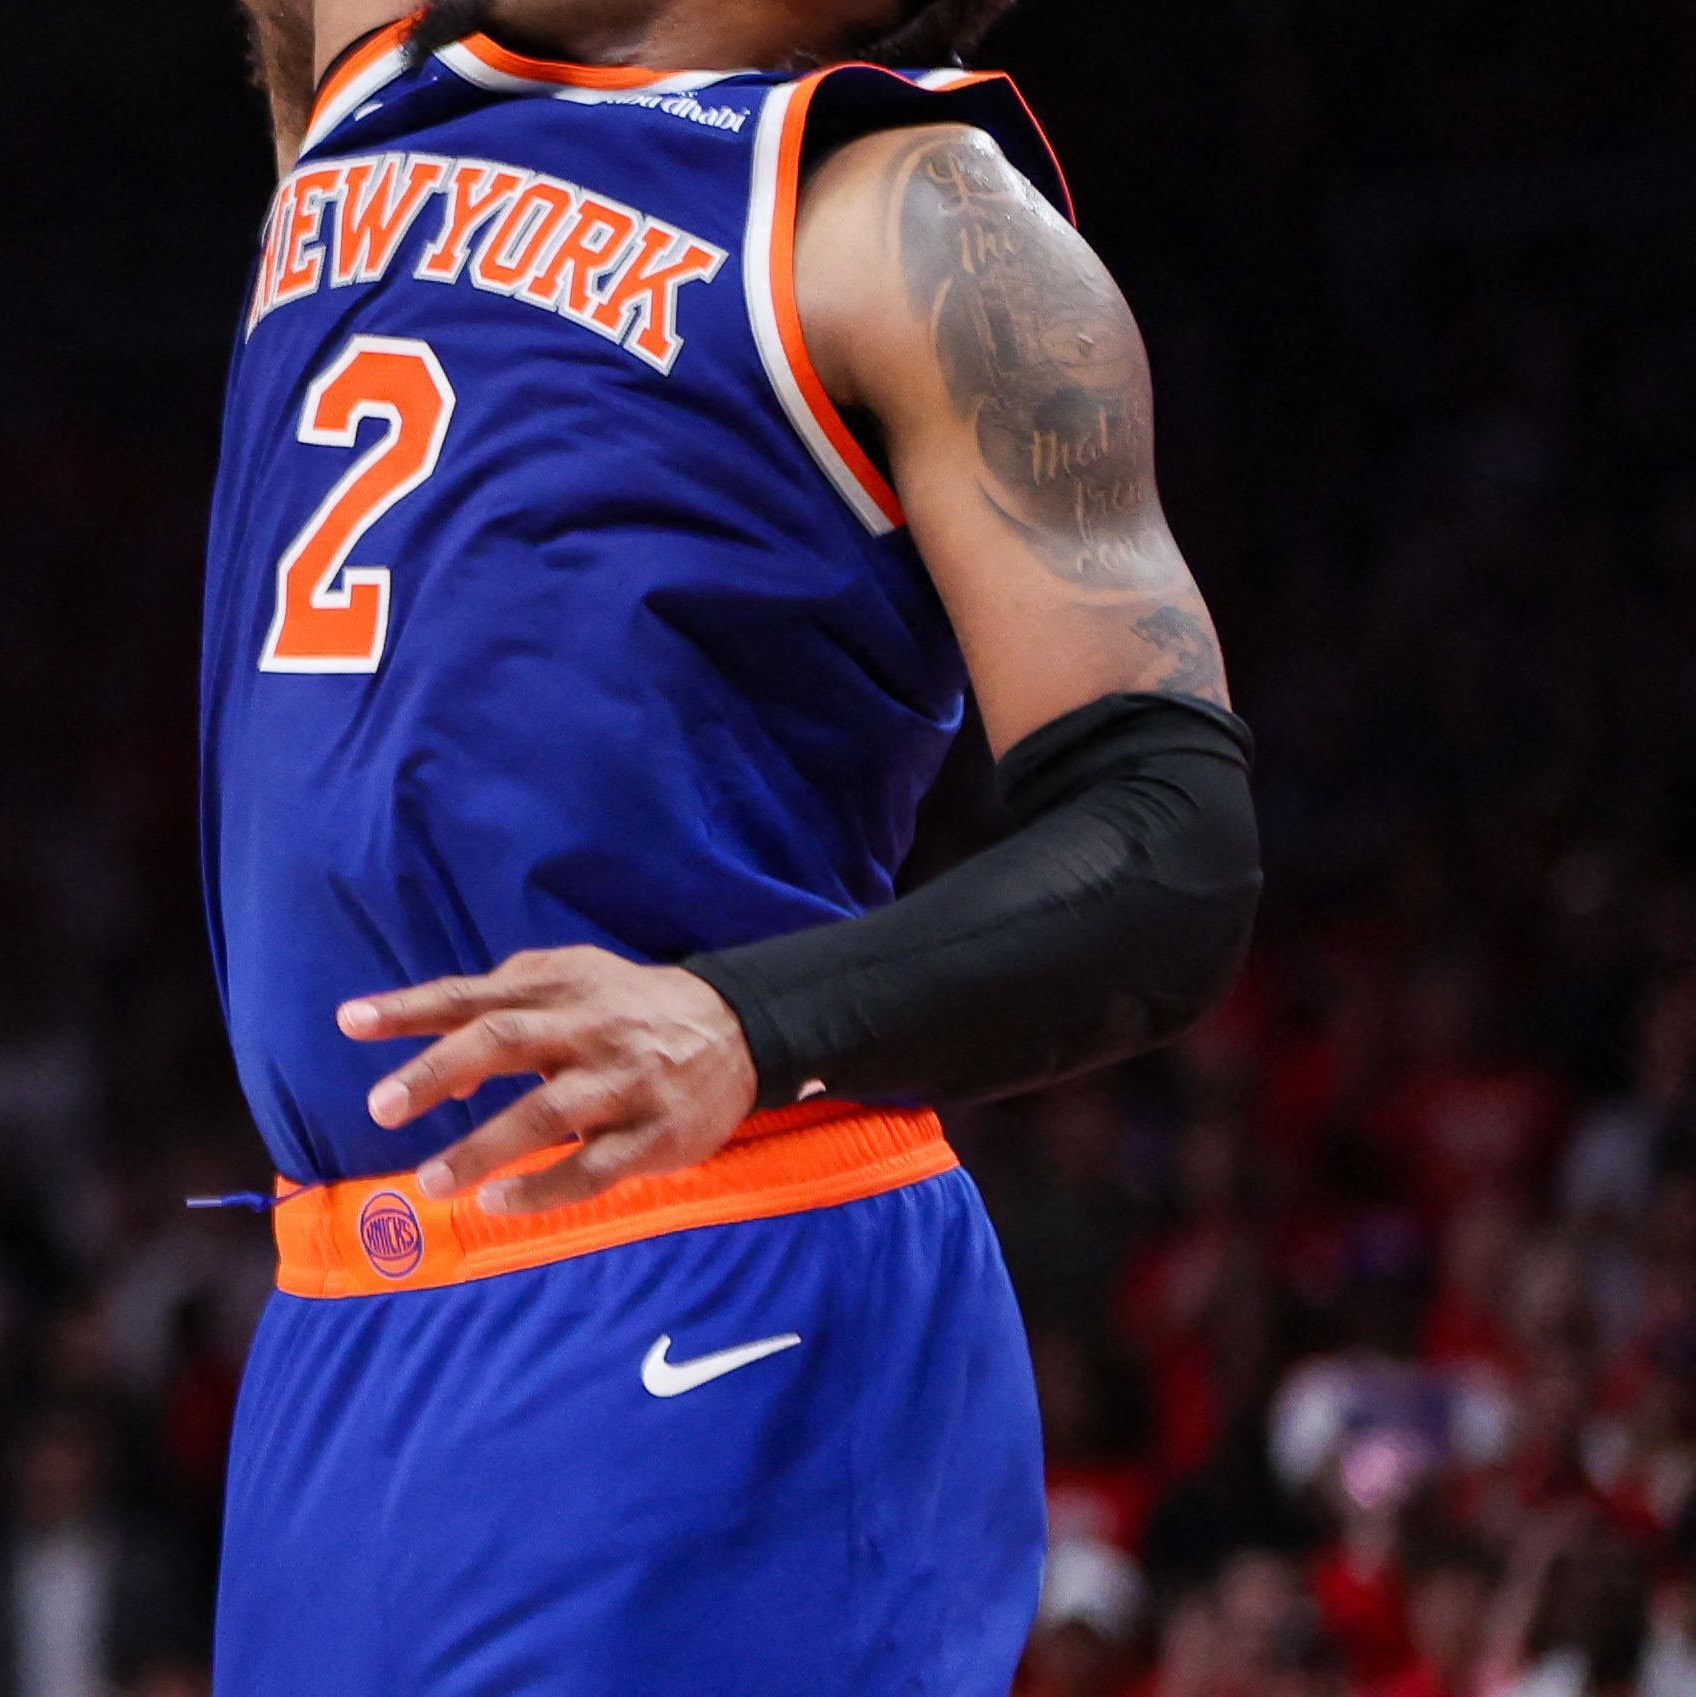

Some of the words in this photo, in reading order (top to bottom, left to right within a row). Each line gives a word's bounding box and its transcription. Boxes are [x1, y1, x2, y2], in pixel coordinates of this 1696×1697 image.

[245, 151, 454, 344] NEW
[413, 156, 730, 378] YORK
[258, 332, 455, 673] 2
